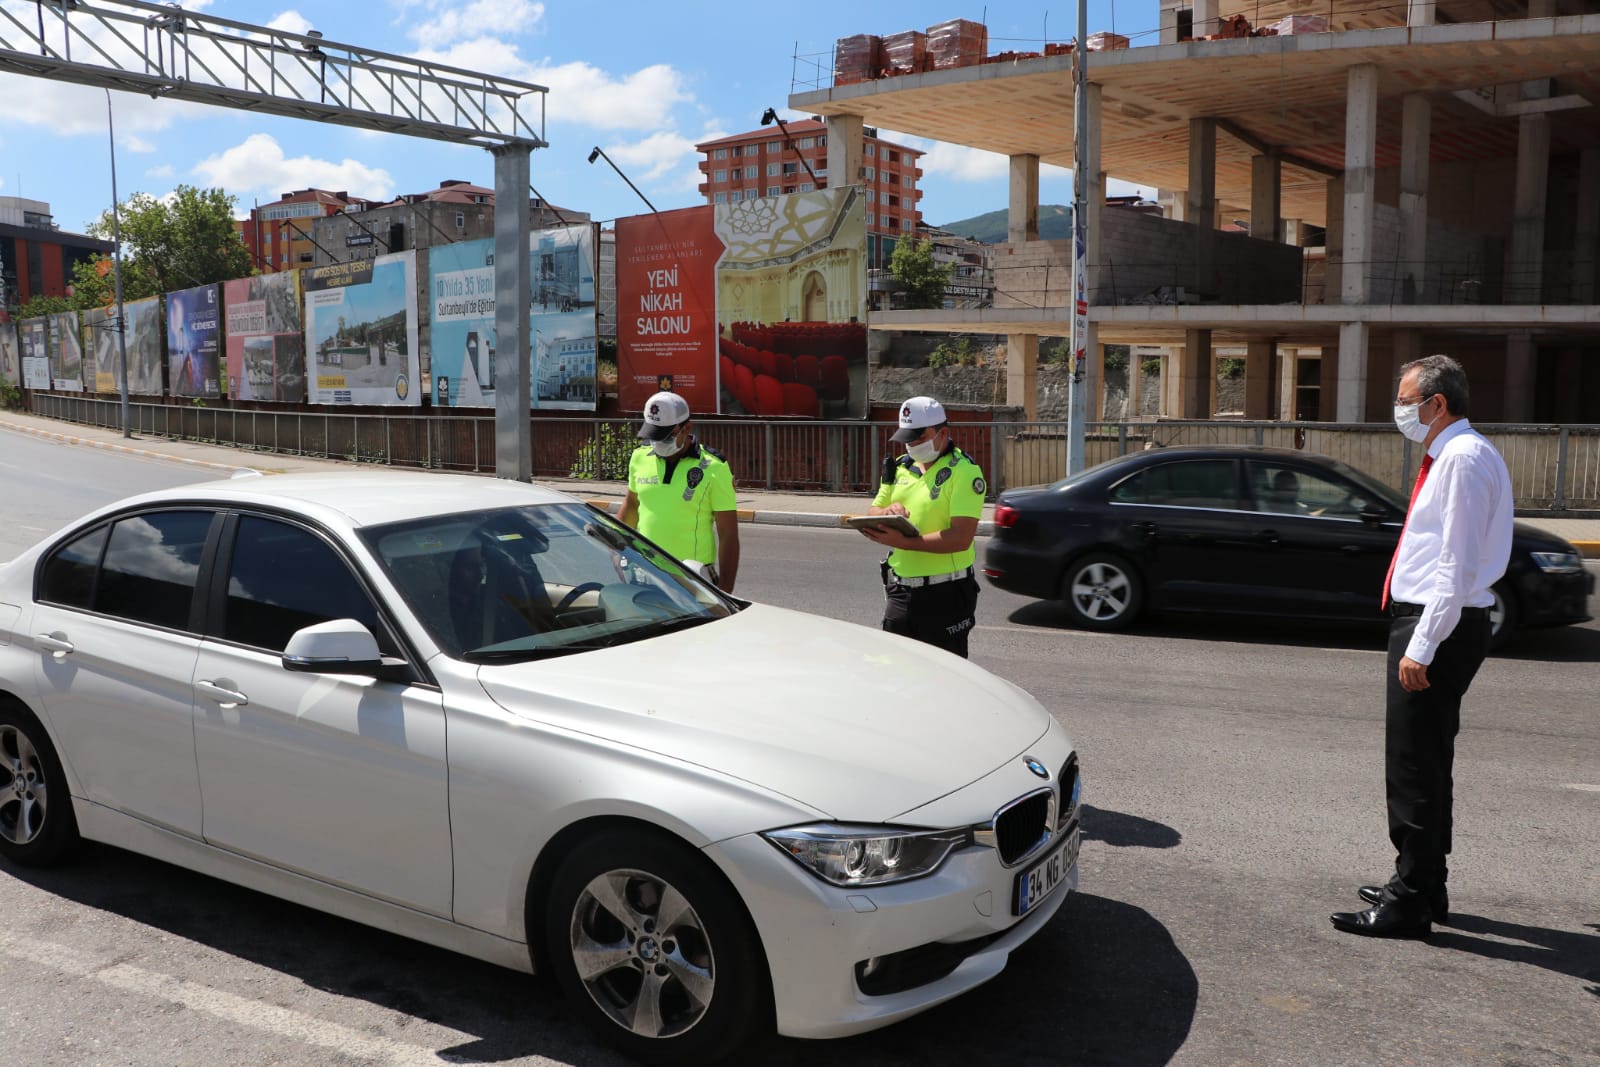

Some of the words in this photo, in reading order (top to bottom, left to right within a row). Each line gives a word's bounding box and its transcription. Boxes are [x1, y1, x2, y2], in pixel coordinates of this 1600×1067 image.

[436, 280, 444, 297] 10
[444, 279, 463, 297] Yılda
[465, 276, 474, 296] 35
[476, 274, 494, 294] Yeni
[647, 263, 678, 288] YENİ
[438, 300, 477, 317] Sultanbeyli'de
[640, 289, 682, 313] NİKAH
[636, 315, 690, 335] SALONU
[1029, 870, 1042, 904] 34
[1046, 854, 1059, 890] NG
